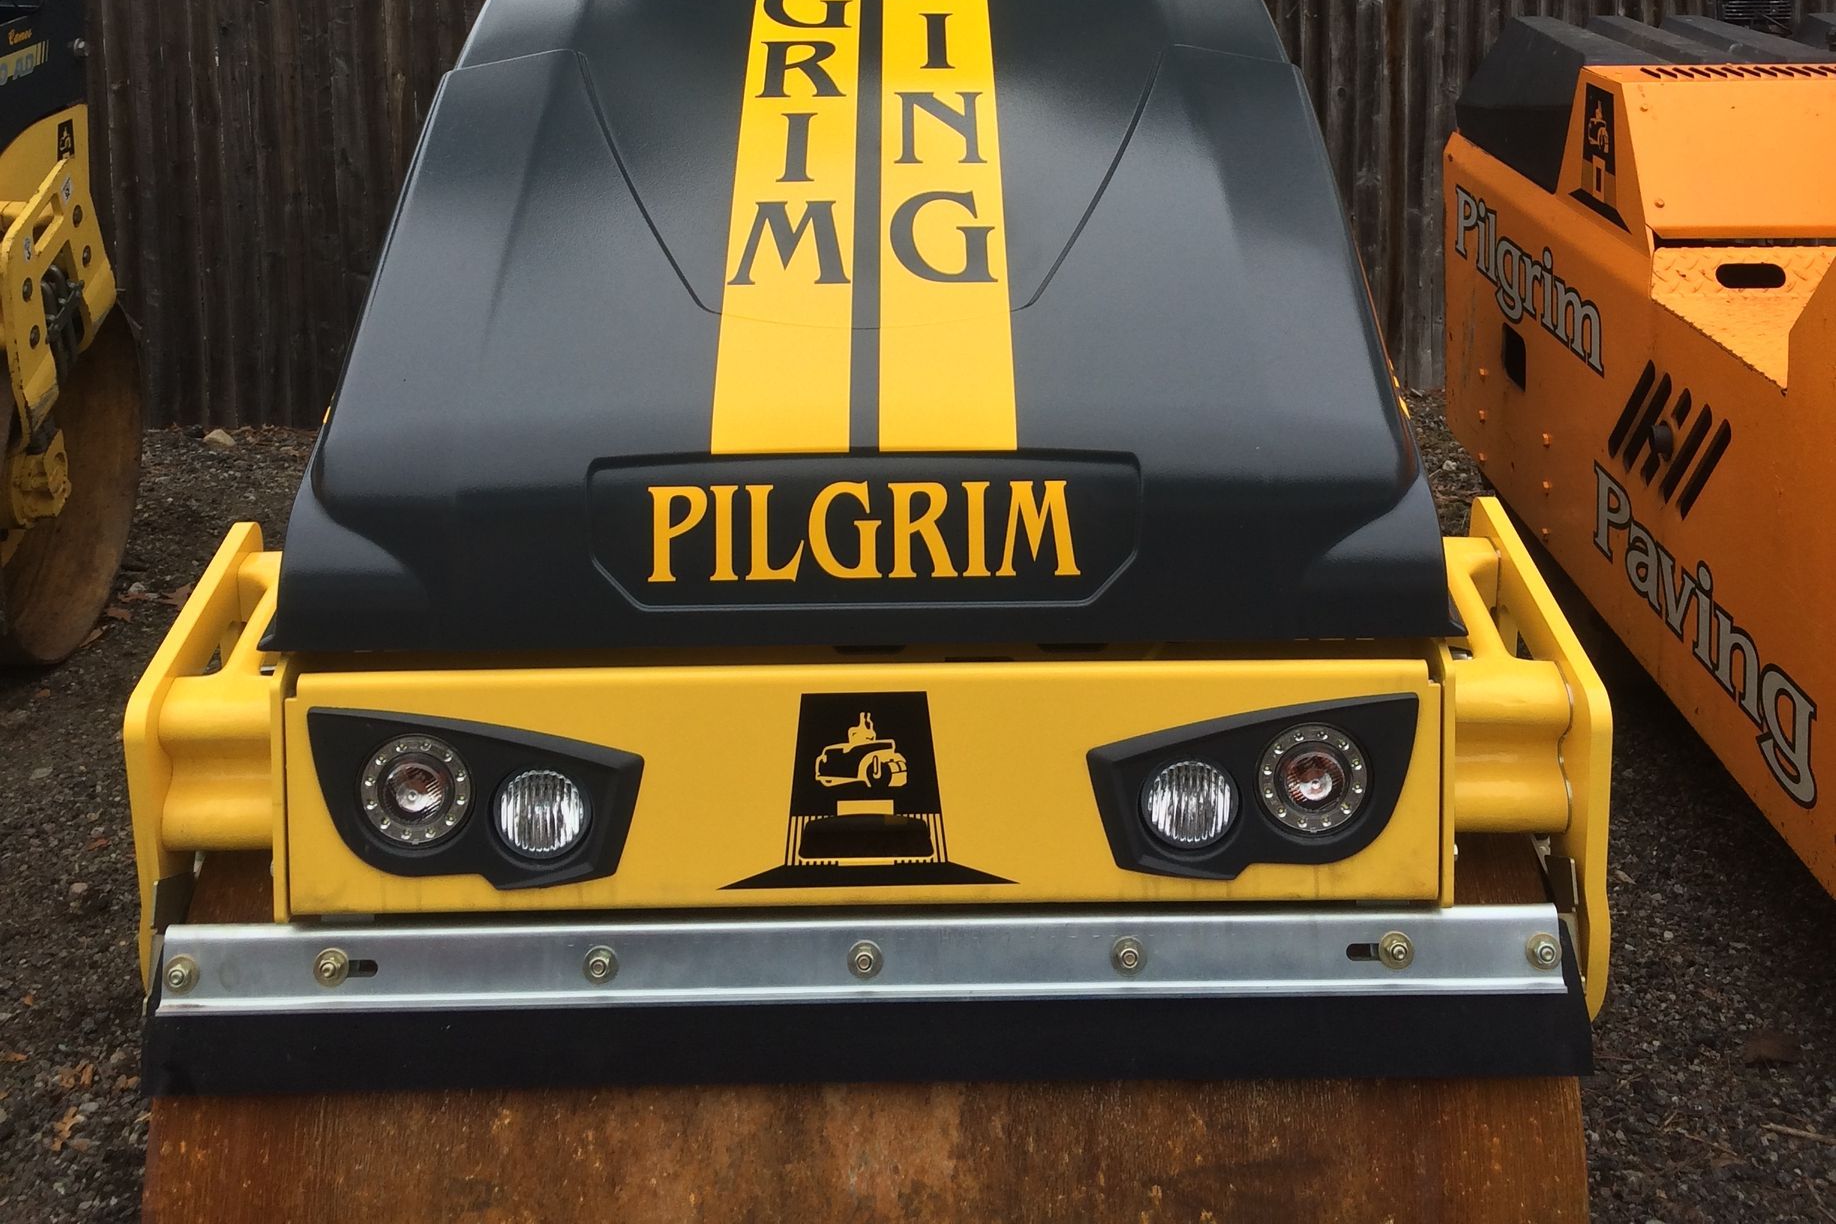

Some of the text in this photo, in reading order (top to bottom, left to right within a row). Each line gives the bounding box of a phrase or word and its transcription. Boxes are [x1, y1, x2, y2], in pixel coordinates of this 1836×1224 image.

[1455, 184, 1605, 378] Pilgrim
[647, 480, 1082, 583] PILGRIM
[1593, 459, 1818, 810] Paving
